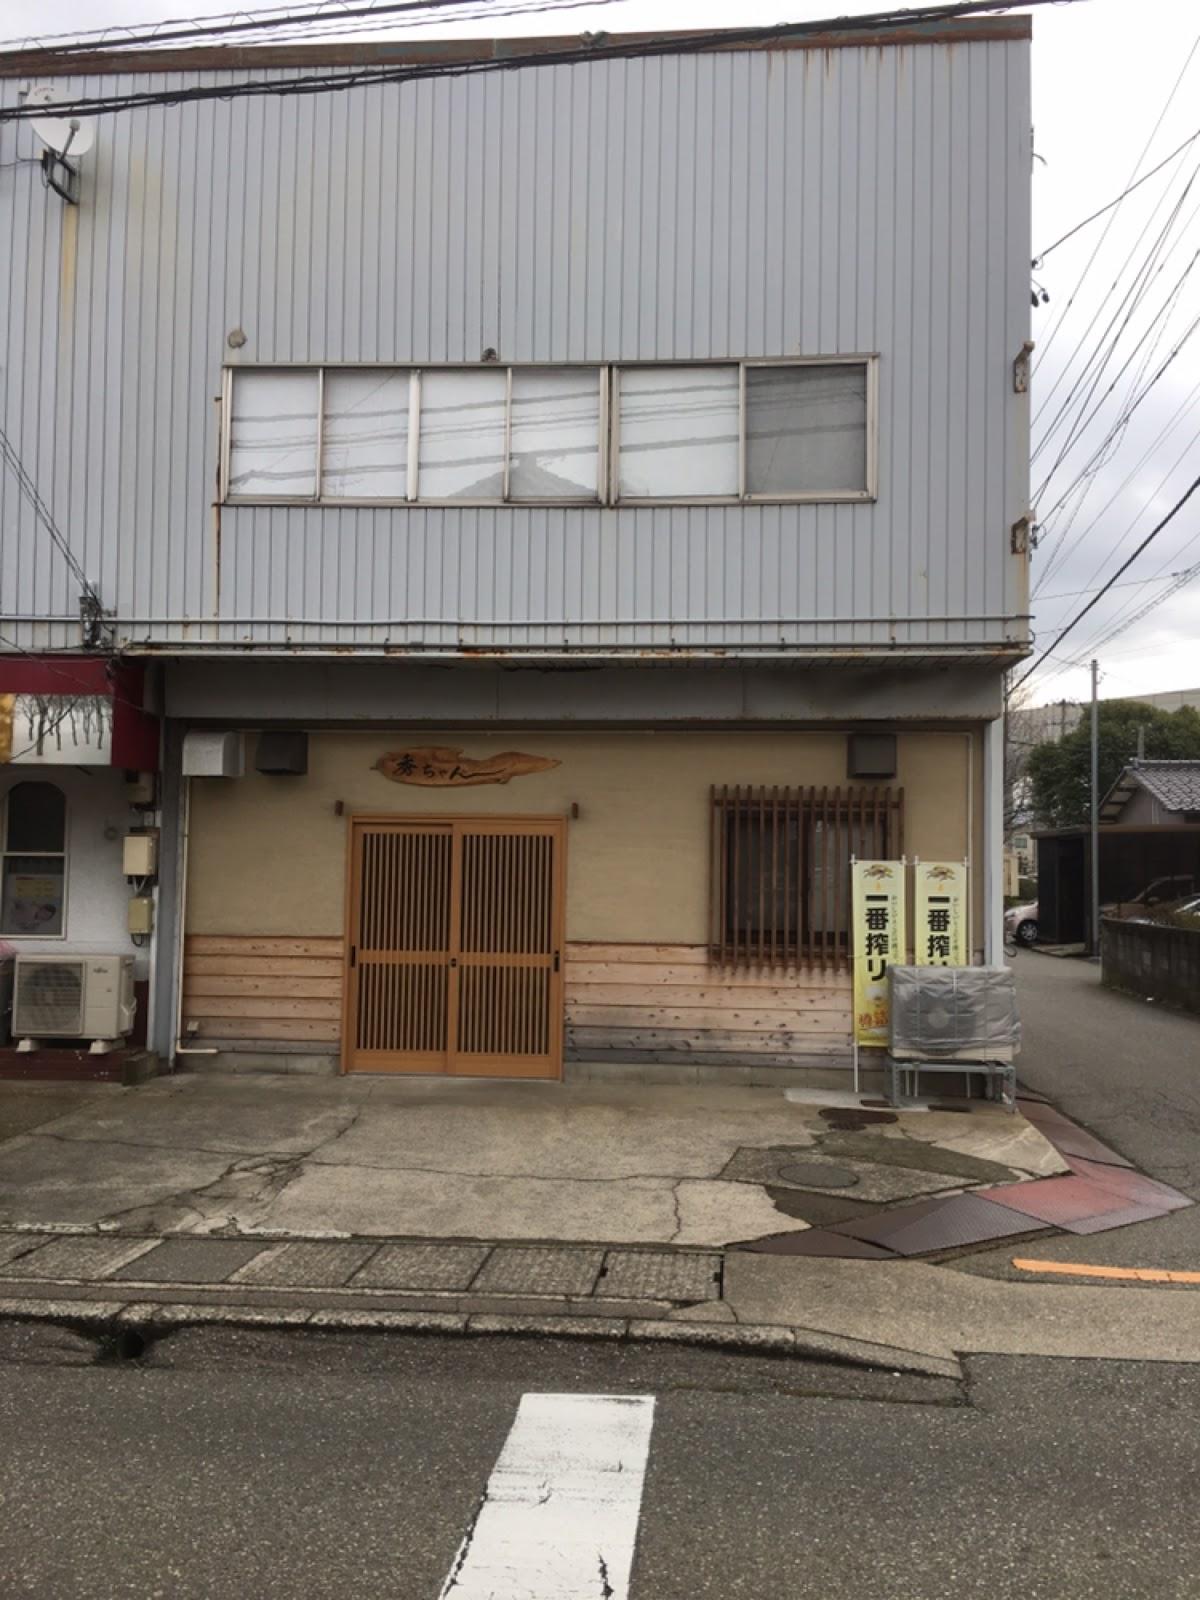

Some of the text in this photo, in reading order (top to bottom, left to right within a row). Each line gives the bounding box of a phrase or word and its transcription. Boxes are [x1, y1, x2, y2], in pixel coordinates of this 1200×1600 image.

[865, 894, 889, 982] 一番搾り
[927, 896, 950, 966] 一番搾
